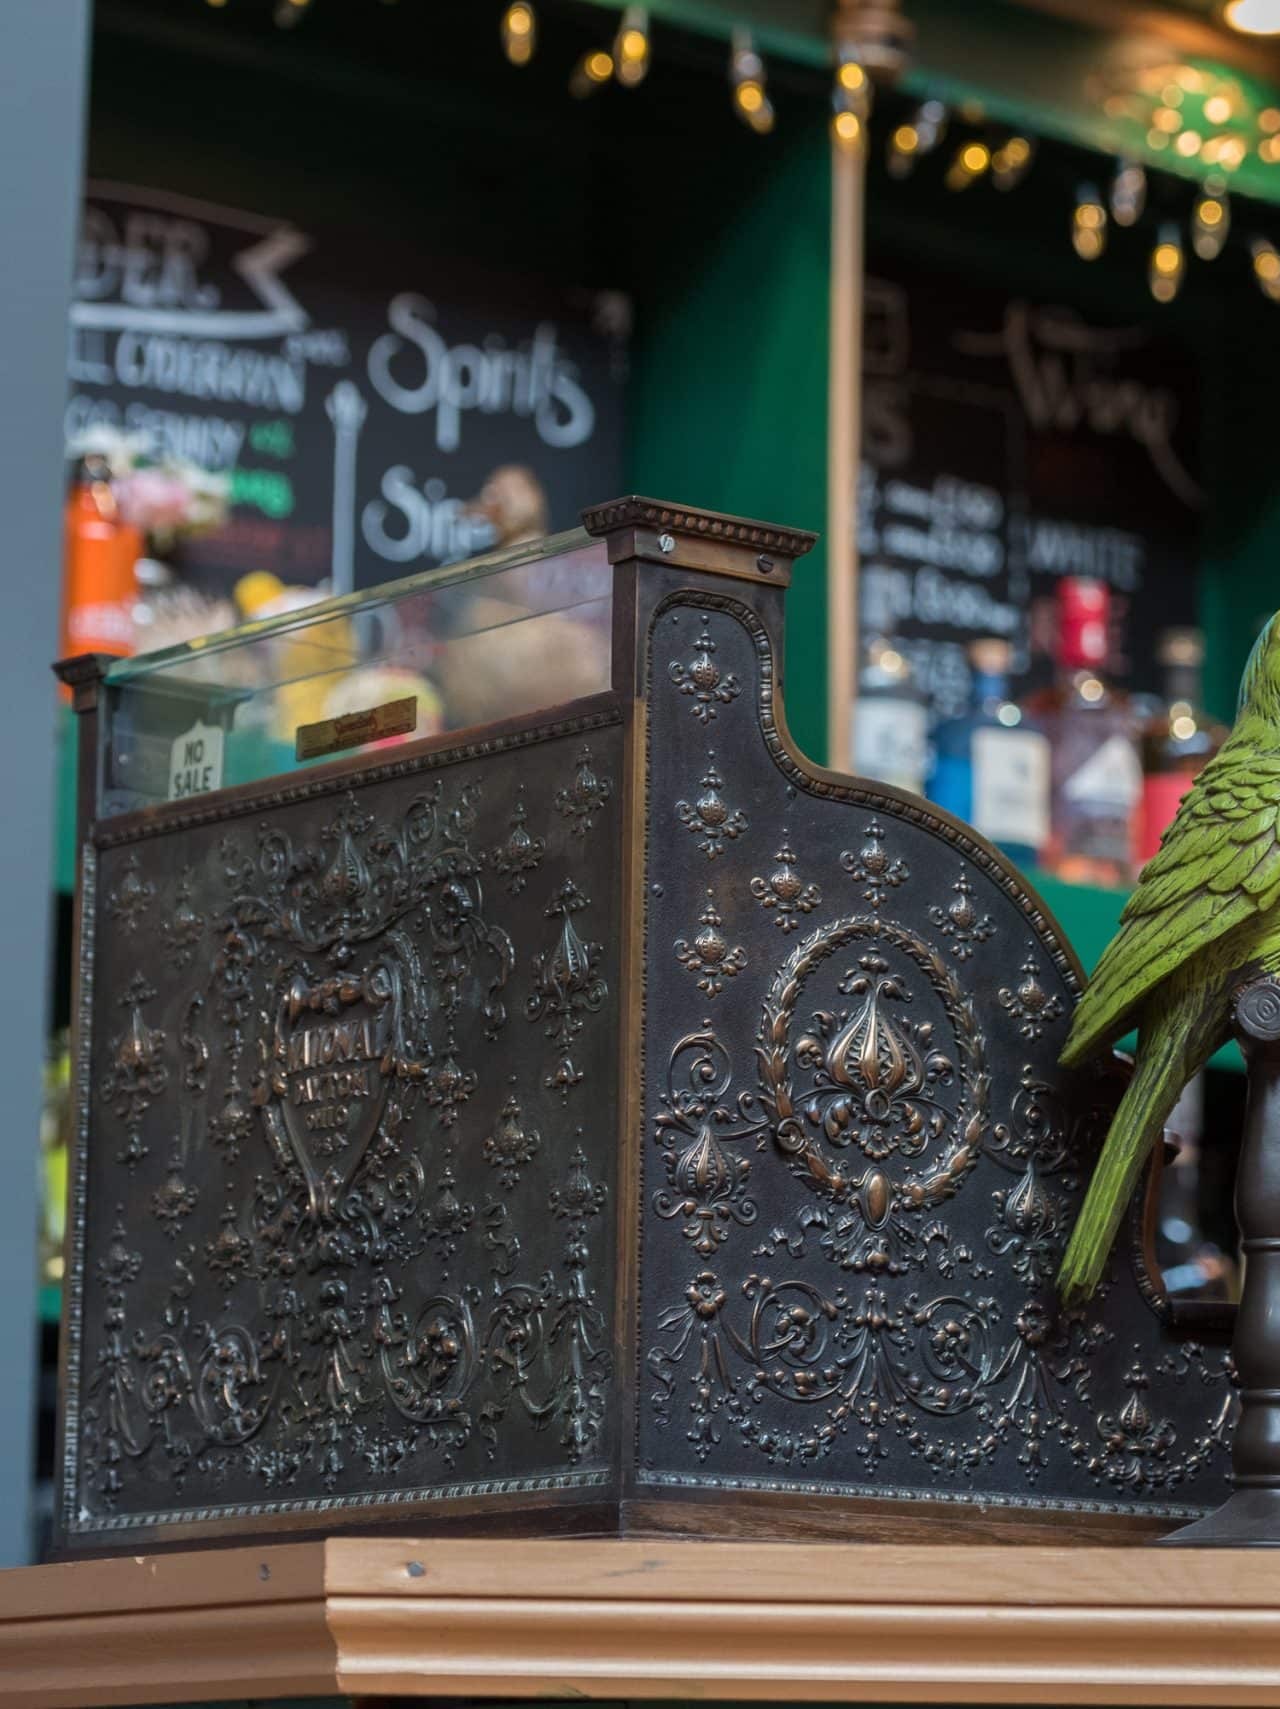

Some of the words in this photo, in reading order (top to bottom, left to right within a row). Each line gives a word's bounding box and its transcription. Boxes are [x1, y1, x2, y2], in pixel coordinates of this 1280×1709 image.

[367, 291, 595, 453] Spirits
[183, 738, 204, 768] NO
[174, 766, 213, 797] SALE
